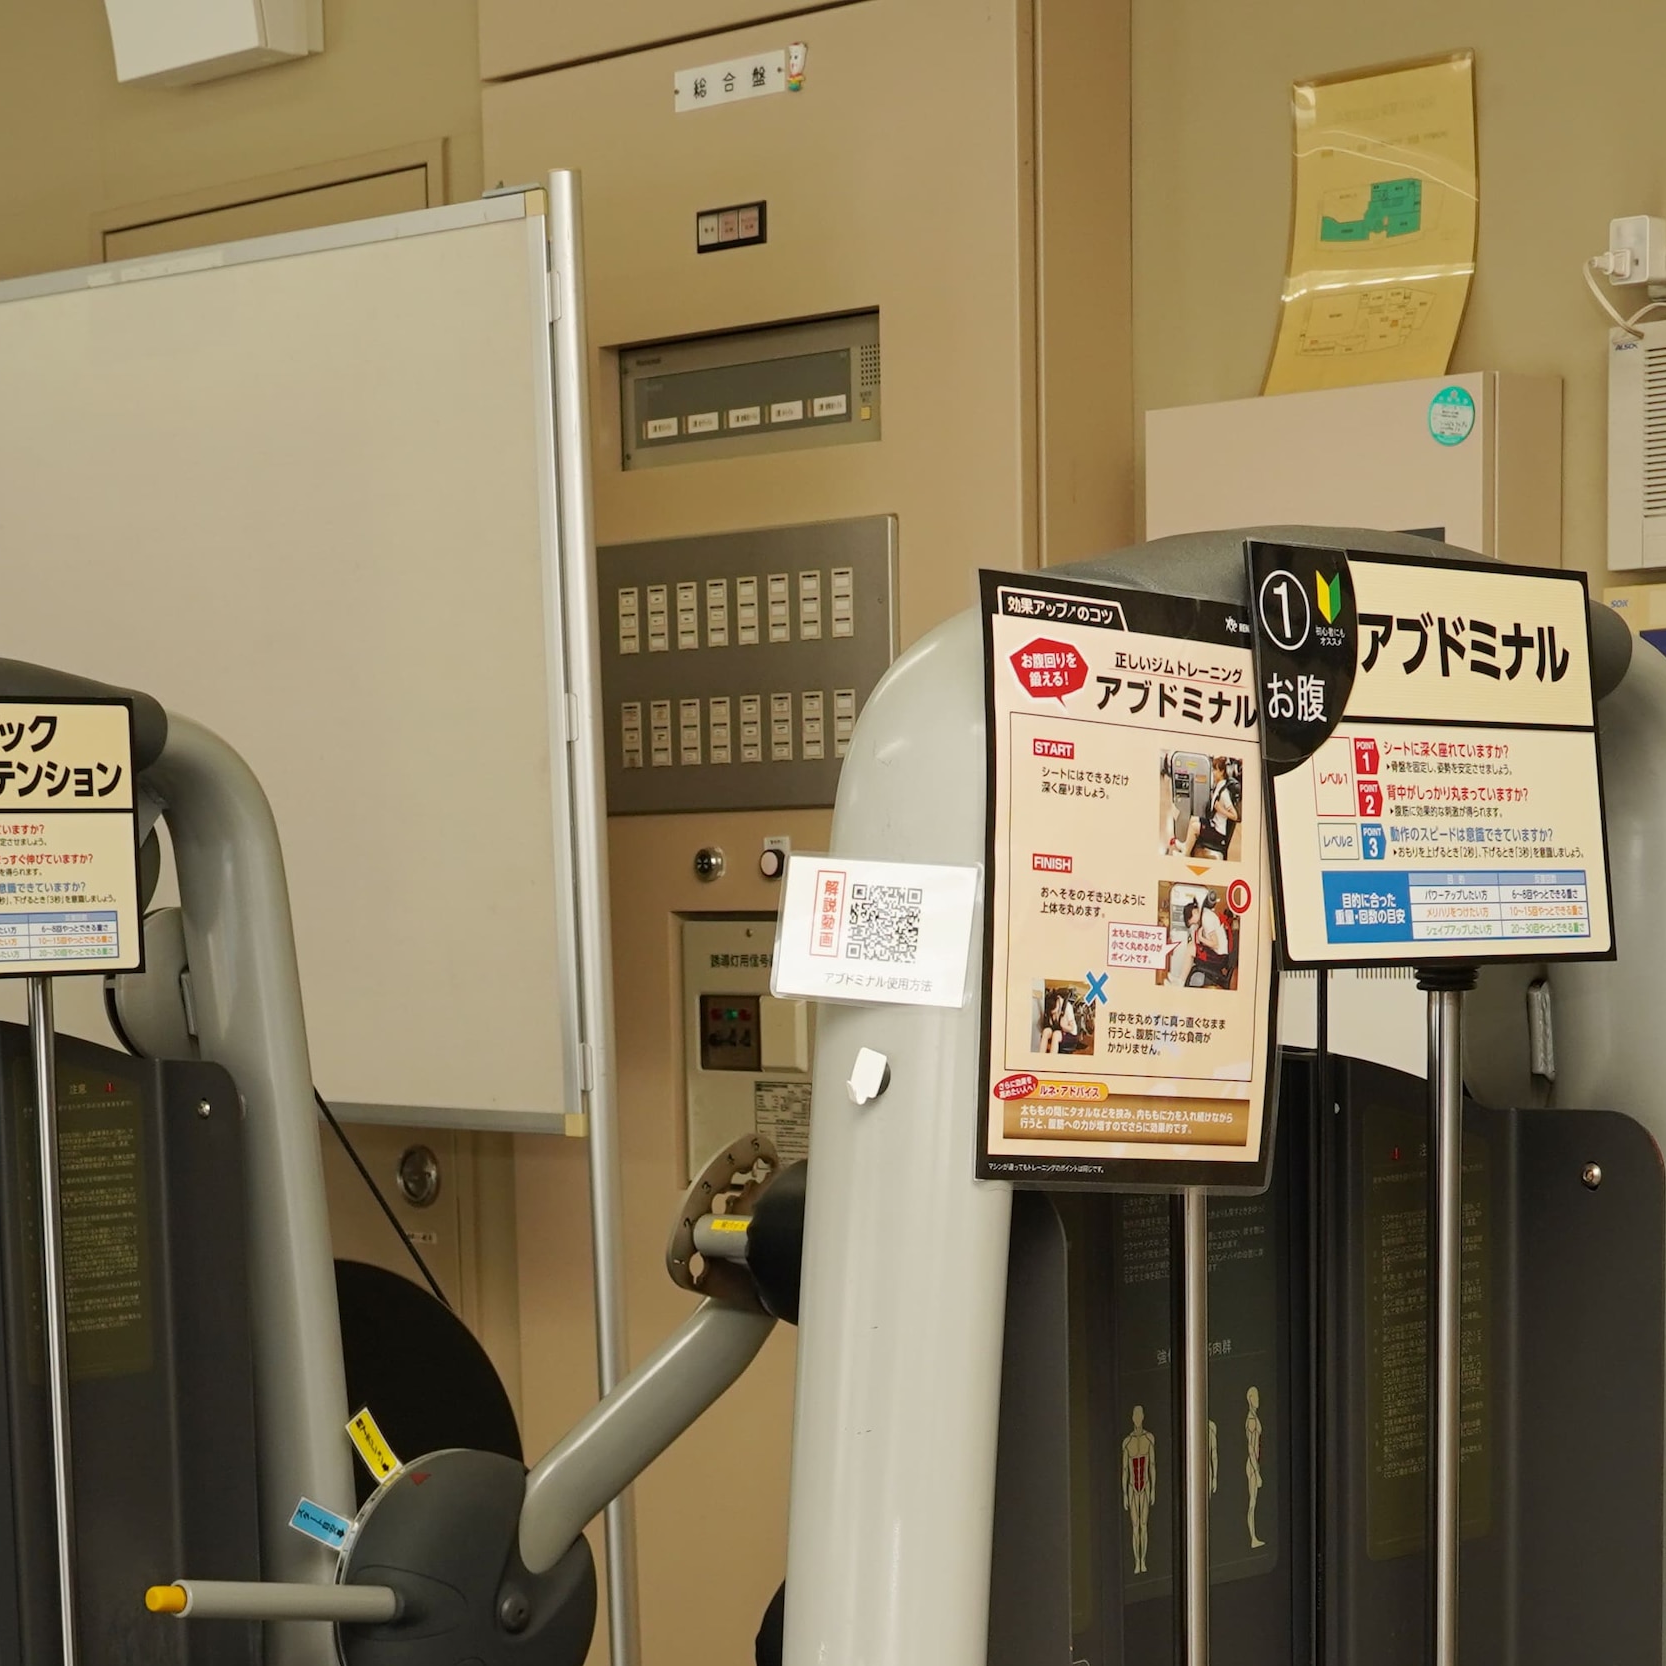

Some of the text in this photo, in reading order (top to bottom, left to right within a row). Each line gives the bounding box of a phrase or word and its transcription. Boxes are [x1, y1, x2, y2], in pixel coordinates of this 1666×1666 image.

[694, 67, 765, 99] 総合盤
[1358, 611, 1570, 683] アブドミナル
[1021, 652, 1077, 669] お腹回りを
[1115, 652, 1243, 683] 正しいジムトレーニング
[1096, 676, 1258, 728] アブドミナル
[1267, 672, 1328, 723] お腹
[1034, 741, 1073, 756] START
[1356, 741, 1375, 751] POINT
[1362, 752, 1371, 772] 1
[1041, 766, 1130, 786] シートにはできるだけ
[1319, 773, 1349, 785] レベル1
[1041, 781, 1110, 800] 深く座りましょう。
[1360, 783, 1378, 794] POINT
[1366, 795, 1376, 814] 2
[1363, 827, 1382, 837] POINT
[1323, 835, 1354, 848] レベル2
[1369, 838, 1378, 858] 3
[1034, 856, 1072, 871] FINISH
[1040, 887, 1146, 906] おへそをのぞき込むように
[1342, 893, 1396, 909] 目的に合った
[819, 880, 839, 948] 解説動画
[1040, 902, 1106, 919] 上体を丸めます。
[1111, 928, 1163, 941] 太ももに向かって
[1111, 940, 1163, 953] 小さく丸めるのが
[825, 972, 933, 993] アブドミナル使用方法
[1109, 1012, 1226, 1030] 背中を丸めずに真っ直ぐなまま
[1107, 1042, 1162, 1056] かかりません。
